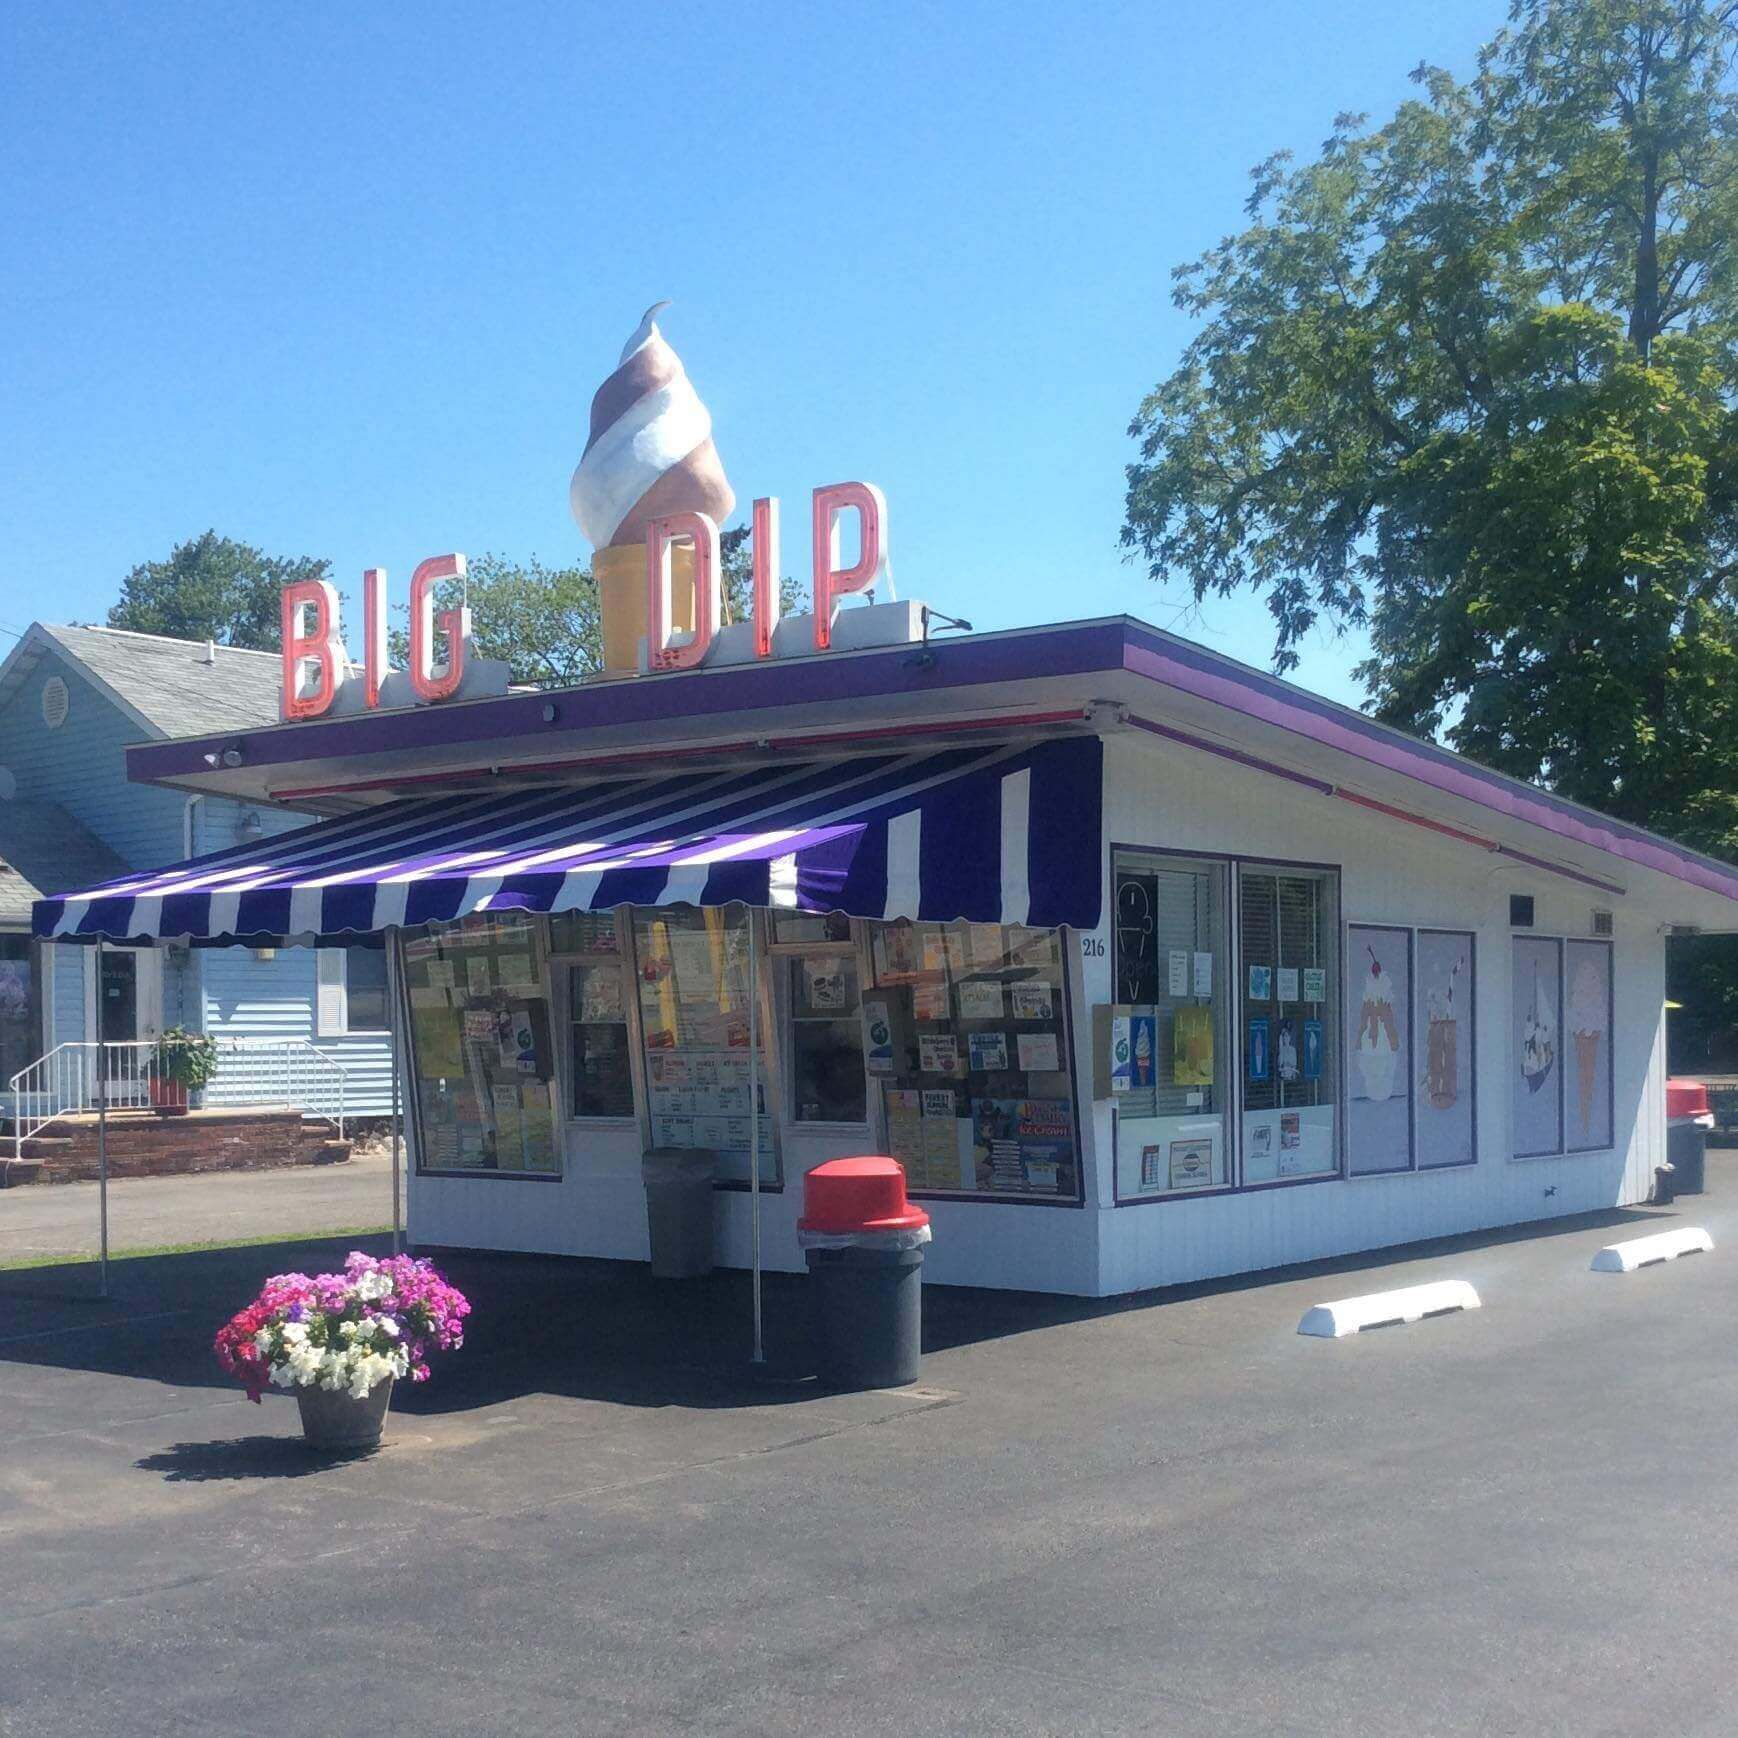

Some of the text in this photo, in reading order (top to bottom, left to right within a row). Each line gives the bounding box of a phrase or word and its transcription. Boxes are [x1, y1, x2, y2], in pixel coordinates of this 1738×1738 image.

[281, 480, 889, 722] BIG DIP
[1082, 938, 1105, 957] 216
